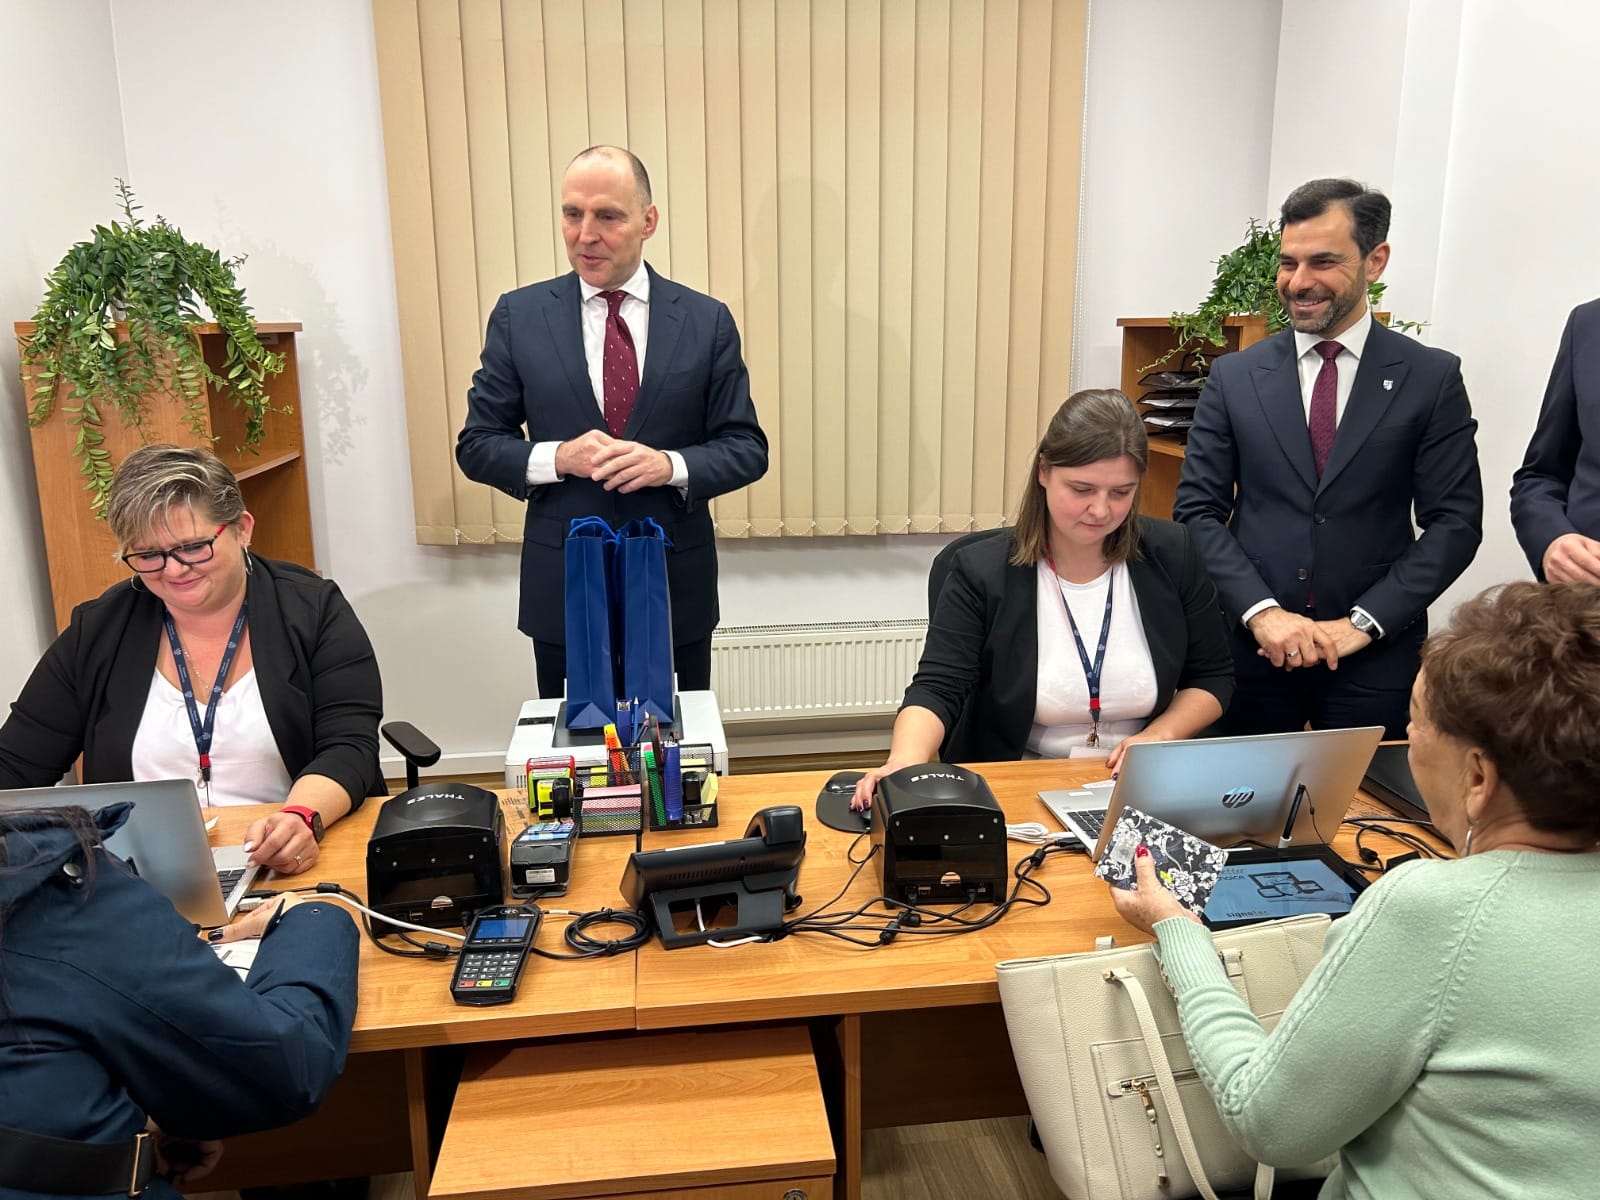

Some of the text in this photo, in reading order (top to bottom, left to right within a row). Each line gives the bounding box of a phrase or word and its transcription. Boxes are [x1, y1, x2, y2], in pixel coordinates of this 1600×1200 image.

[910, 773, 964, 782] THALES
[406, 793, 465, 805] THALES
[1222, 786, 1255, 808] hp
